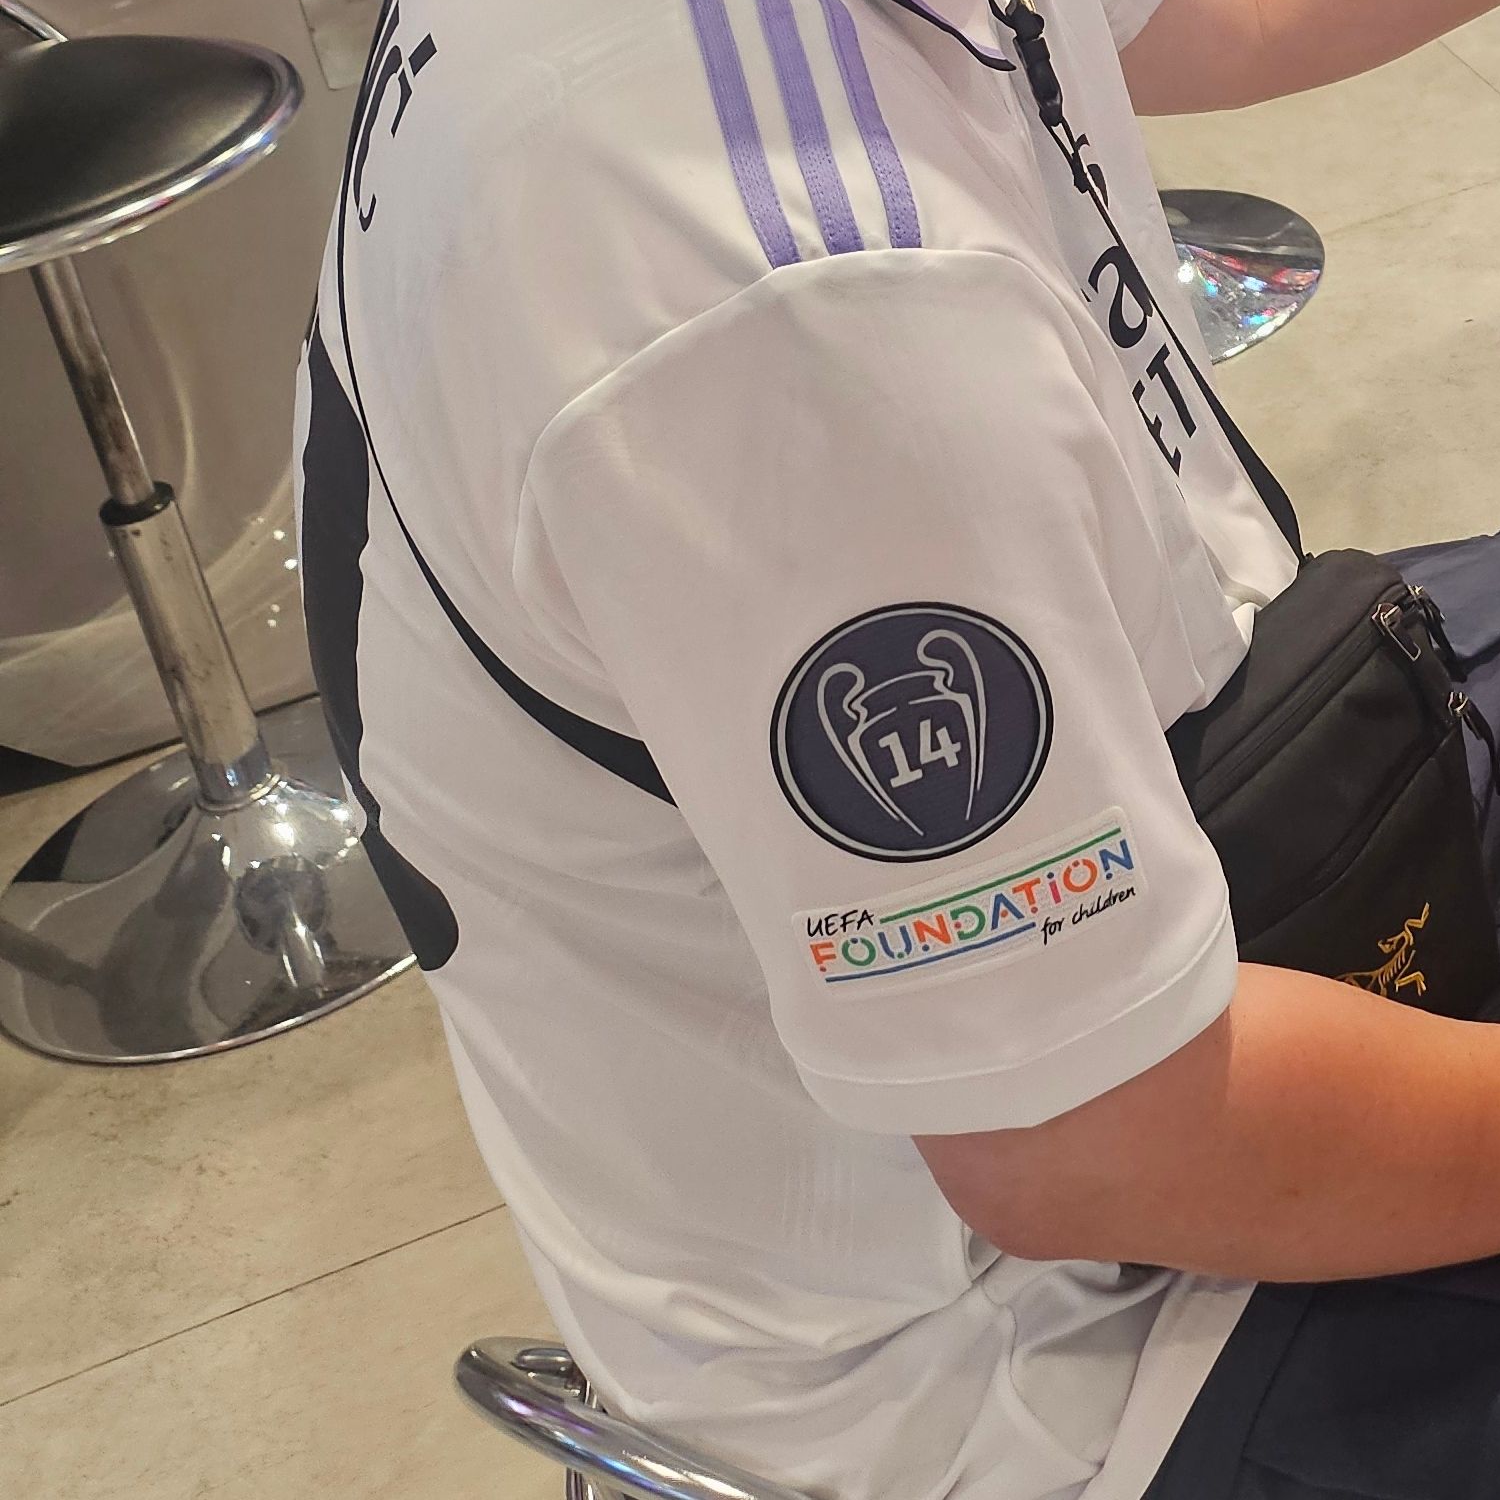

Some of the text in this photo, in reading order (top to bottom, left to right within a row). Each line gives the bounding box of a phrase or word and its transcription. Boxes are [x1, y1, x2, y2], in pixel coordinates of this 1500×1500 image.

[878, 719, 962, 788] 14
[806, 909, 875, 938] UEFA
[1041, 886, 1137, 945] for children
